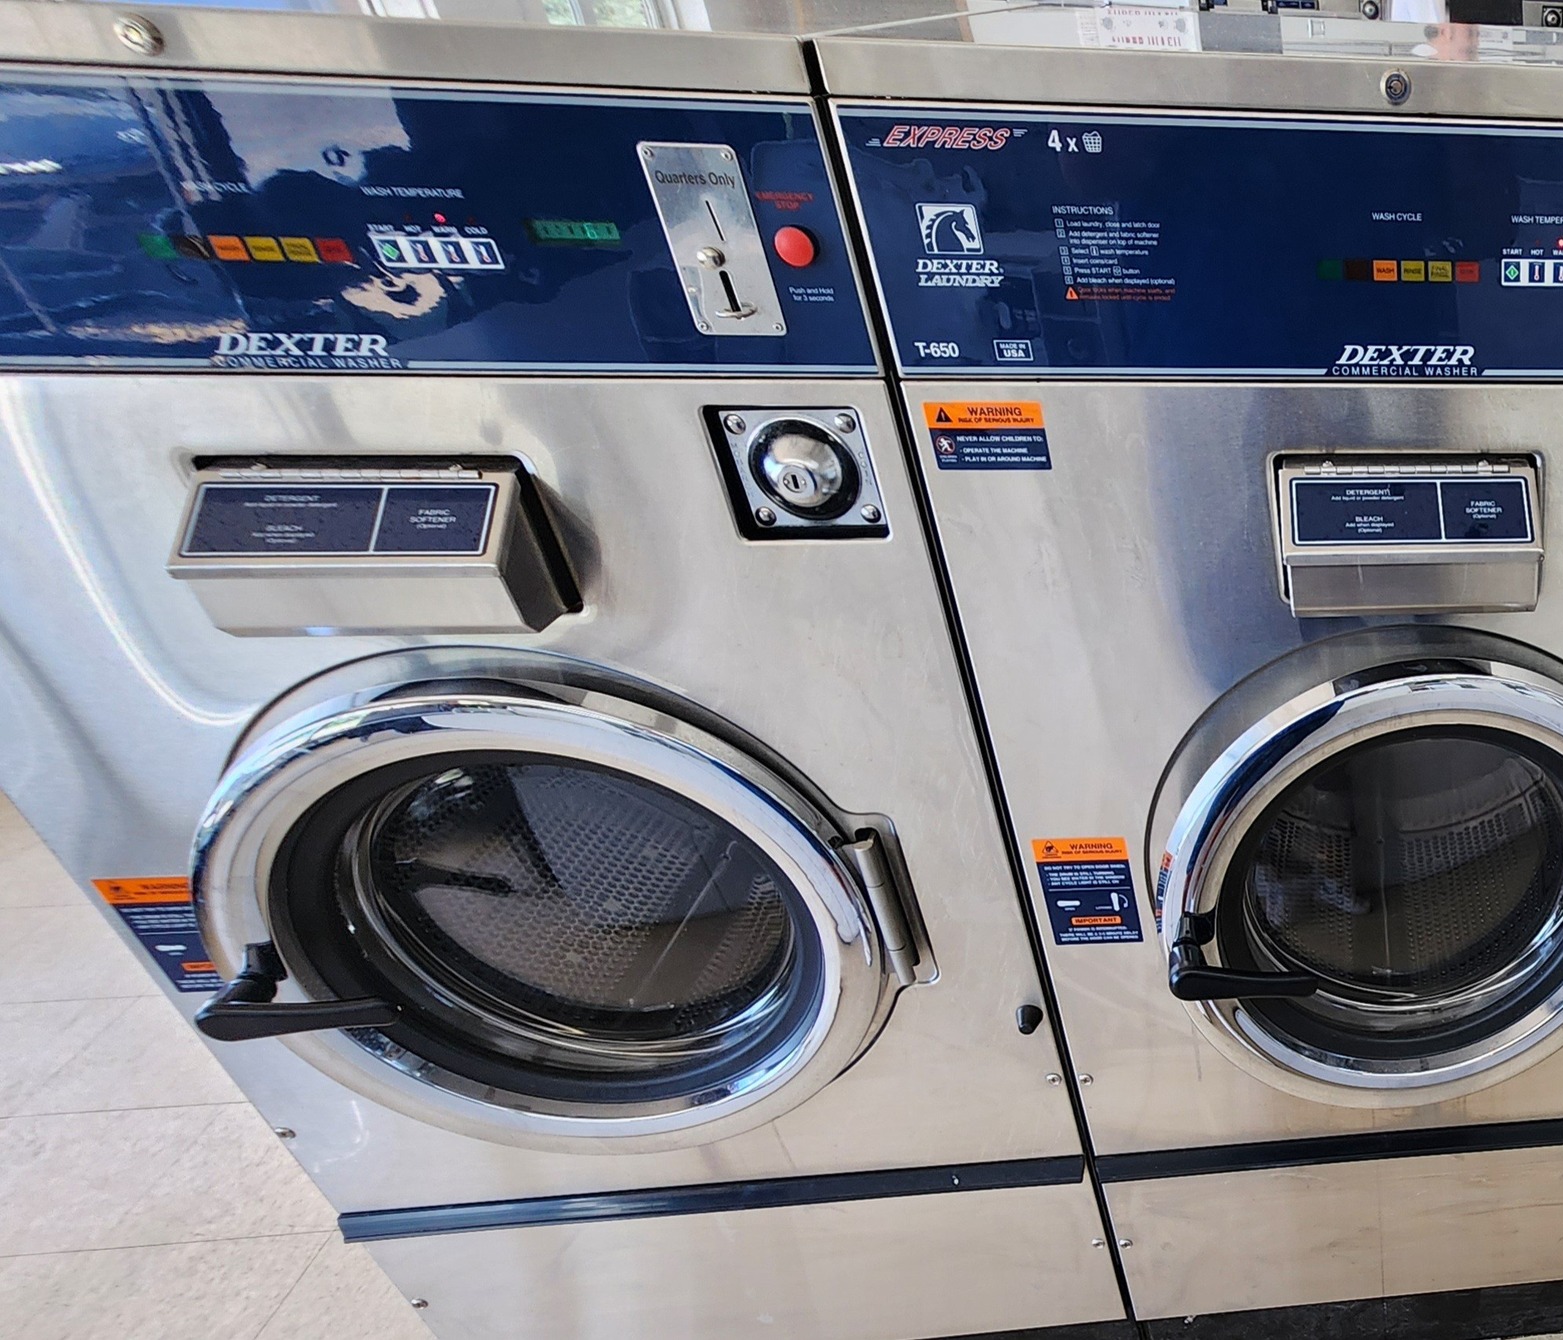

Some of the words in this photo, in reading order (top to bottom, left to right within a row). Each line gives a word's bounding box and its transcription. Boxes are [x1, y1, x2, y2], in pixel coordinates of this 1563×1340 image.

[883, 126, 1010, 149] EXPRESS
[1048, 130, 1063, 152] 4
[655, 171, 707, 186] Quarters
[709, 173, 735, 189] Only
[359, 186, 392, 197] WASH
[392, 188, 464, 200] TEMPERATURE
[775, 202, 800, 211] STOP
[1052, 206, 1114, 215] INSTRUCTIONS
[1372, 213, 1396, 222] WASH
[1397, 213, 1422, 222] CYCLE
[1511, 215, 1535, 225] WASH
[1502, 248, 1522, 256] START
[1530, 248, 1544, 256] HOT
[916, 260, 999, 273] DEXTER
[918, 275, 1003, 286] LAUNDRY
[789, 287, 806, 295] Push
[214, 333, 389, 357] DEXTER
[915, 343, 959, 357] T-650
[1335, 345, 1475, 365] DEXTER
[211, 356, 329, 368] COMMERCIAL
[334, 358, 402, 369] WASHER
[1332, 367, 1420, 376] COMMERCIAL
[1424, 367, 1478, 376] WASHER
[967, 407, 1022, 416] WARNING
[264, 495, 321, 503] DETERGENT
[418, 509, 451, 517] FABRIC
[410, 516, 456, 524] SOFTENER
